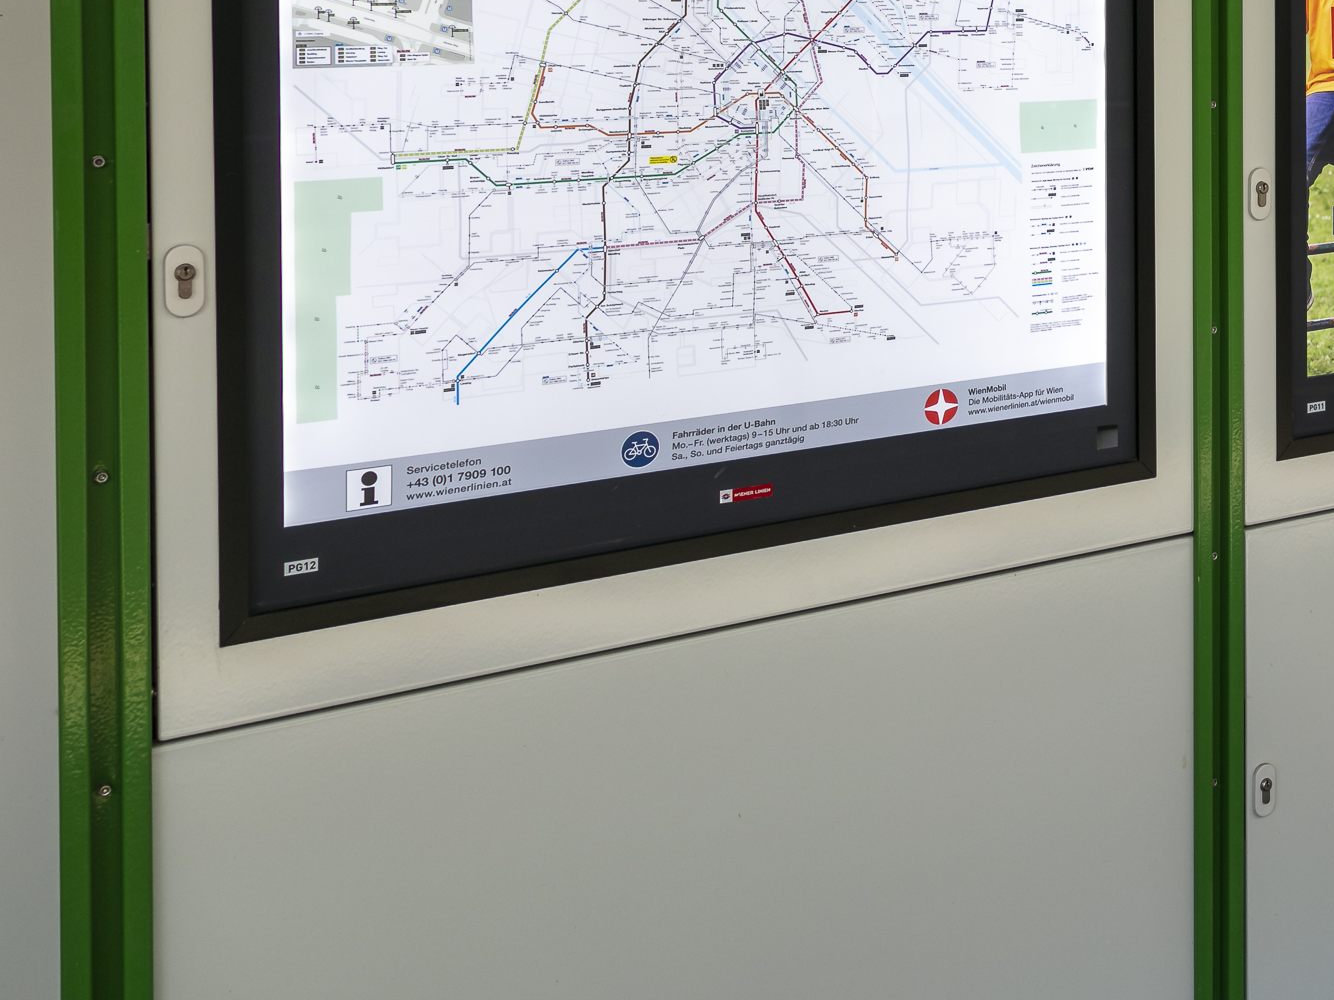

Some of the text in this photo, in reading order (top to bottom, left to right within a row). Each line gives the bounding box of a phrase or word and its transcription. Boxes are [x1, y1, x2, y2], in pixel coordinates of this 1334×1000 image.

[968, 384, 1007, 396] WienMobil
[969, 386, 1064, 406] Die Mobilitäts-App für Wien
[968, 394, 1075, 416] www.wienerlinien.at/wienmobil
[672, 418, 776, 439] Fahrräder in der U-Bahn
[706, 433, 750, 447] (werktags)
[776, 426, 790, 436] Uhr
[792, 424, 807, 433] und
[809, 422, 820, 431] ab
[822, 418, 843, 428] 18:30
[845, 417, 859, 425] Uhr
[671, 434, 805, 461] Sa., So. und Feiertags ganztägig
[407, 458, 482, 474] Servicetelefon
[407, 465, 511, 488] +43 (0)1 7909 100
[406, 478, 512, 500] www.wienerlinien.at
[288, 561, 316, 573] PG12
